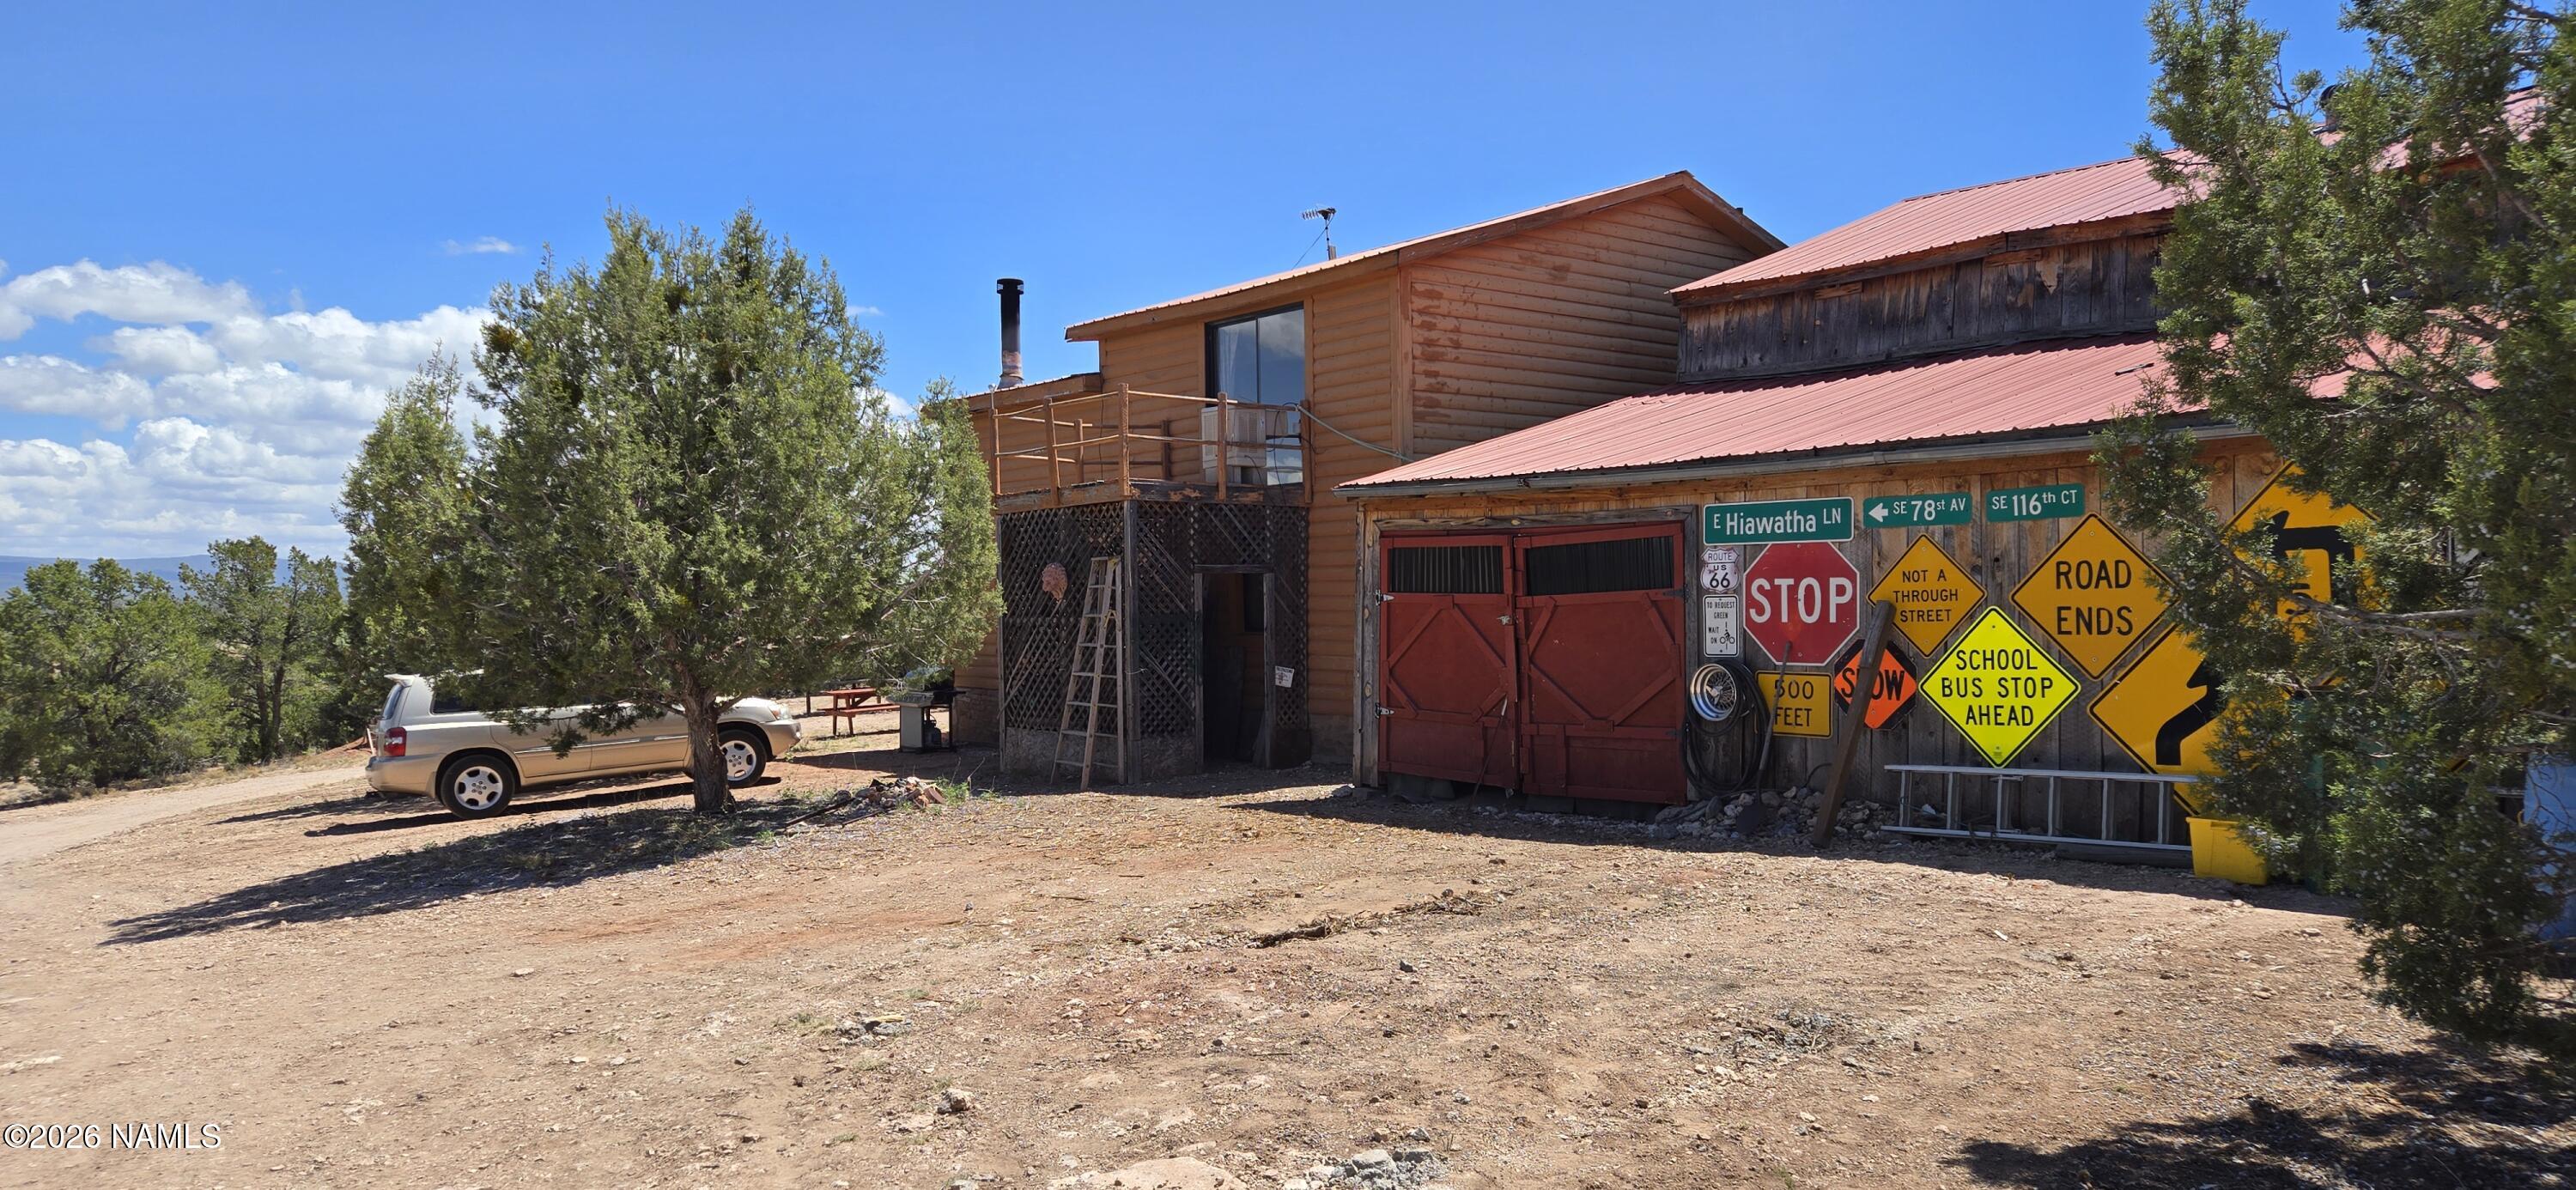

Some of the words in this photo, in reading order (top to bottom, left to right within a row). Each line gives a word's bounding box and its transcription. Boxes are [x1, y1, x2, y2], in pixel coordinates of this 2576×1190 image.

[1893, 501, 1908, 515] SE
[1911, 499, 1946, 521] 78st
[1950, 498, 1966, 512] AV
[1991, 495, 2008, 510] SE
[2012, 491, 2057, 516] 116th
[2061, 490, 2078, 504] CT
[1714, 514, 1722, 529] E
[1726, 510, 1817, 536] Hiawatha
[1823, 507, 1841, 525] LN
[1708, 552, 1733, 562] ROUTE
[1710, 572, 1731, 589] 66
[1902, 569, 1928, 583] NOT
[1937, 568, 1947, 582] A
[2056, 559, 2132, 590] ROAD
[1749, 576, 1853, 624] STOP
[1893, 588, 1959, 604] THROUGH
[1899, 609, 1952, 622] STREET
[2057, 605, 2134, 636] ENDS
[1955, 648, 2038, 671] SCHOOL
[1774, 679, 1814, 700] 500
[1840, 667, 1905, 701] SOW
[1941, 677, 1984, 699] BUS
[1997, 677, 2054, 699] STOP
[1773, 707, 1812, 727] FEET
[1965, 704, 2034, 726] AHEAD
